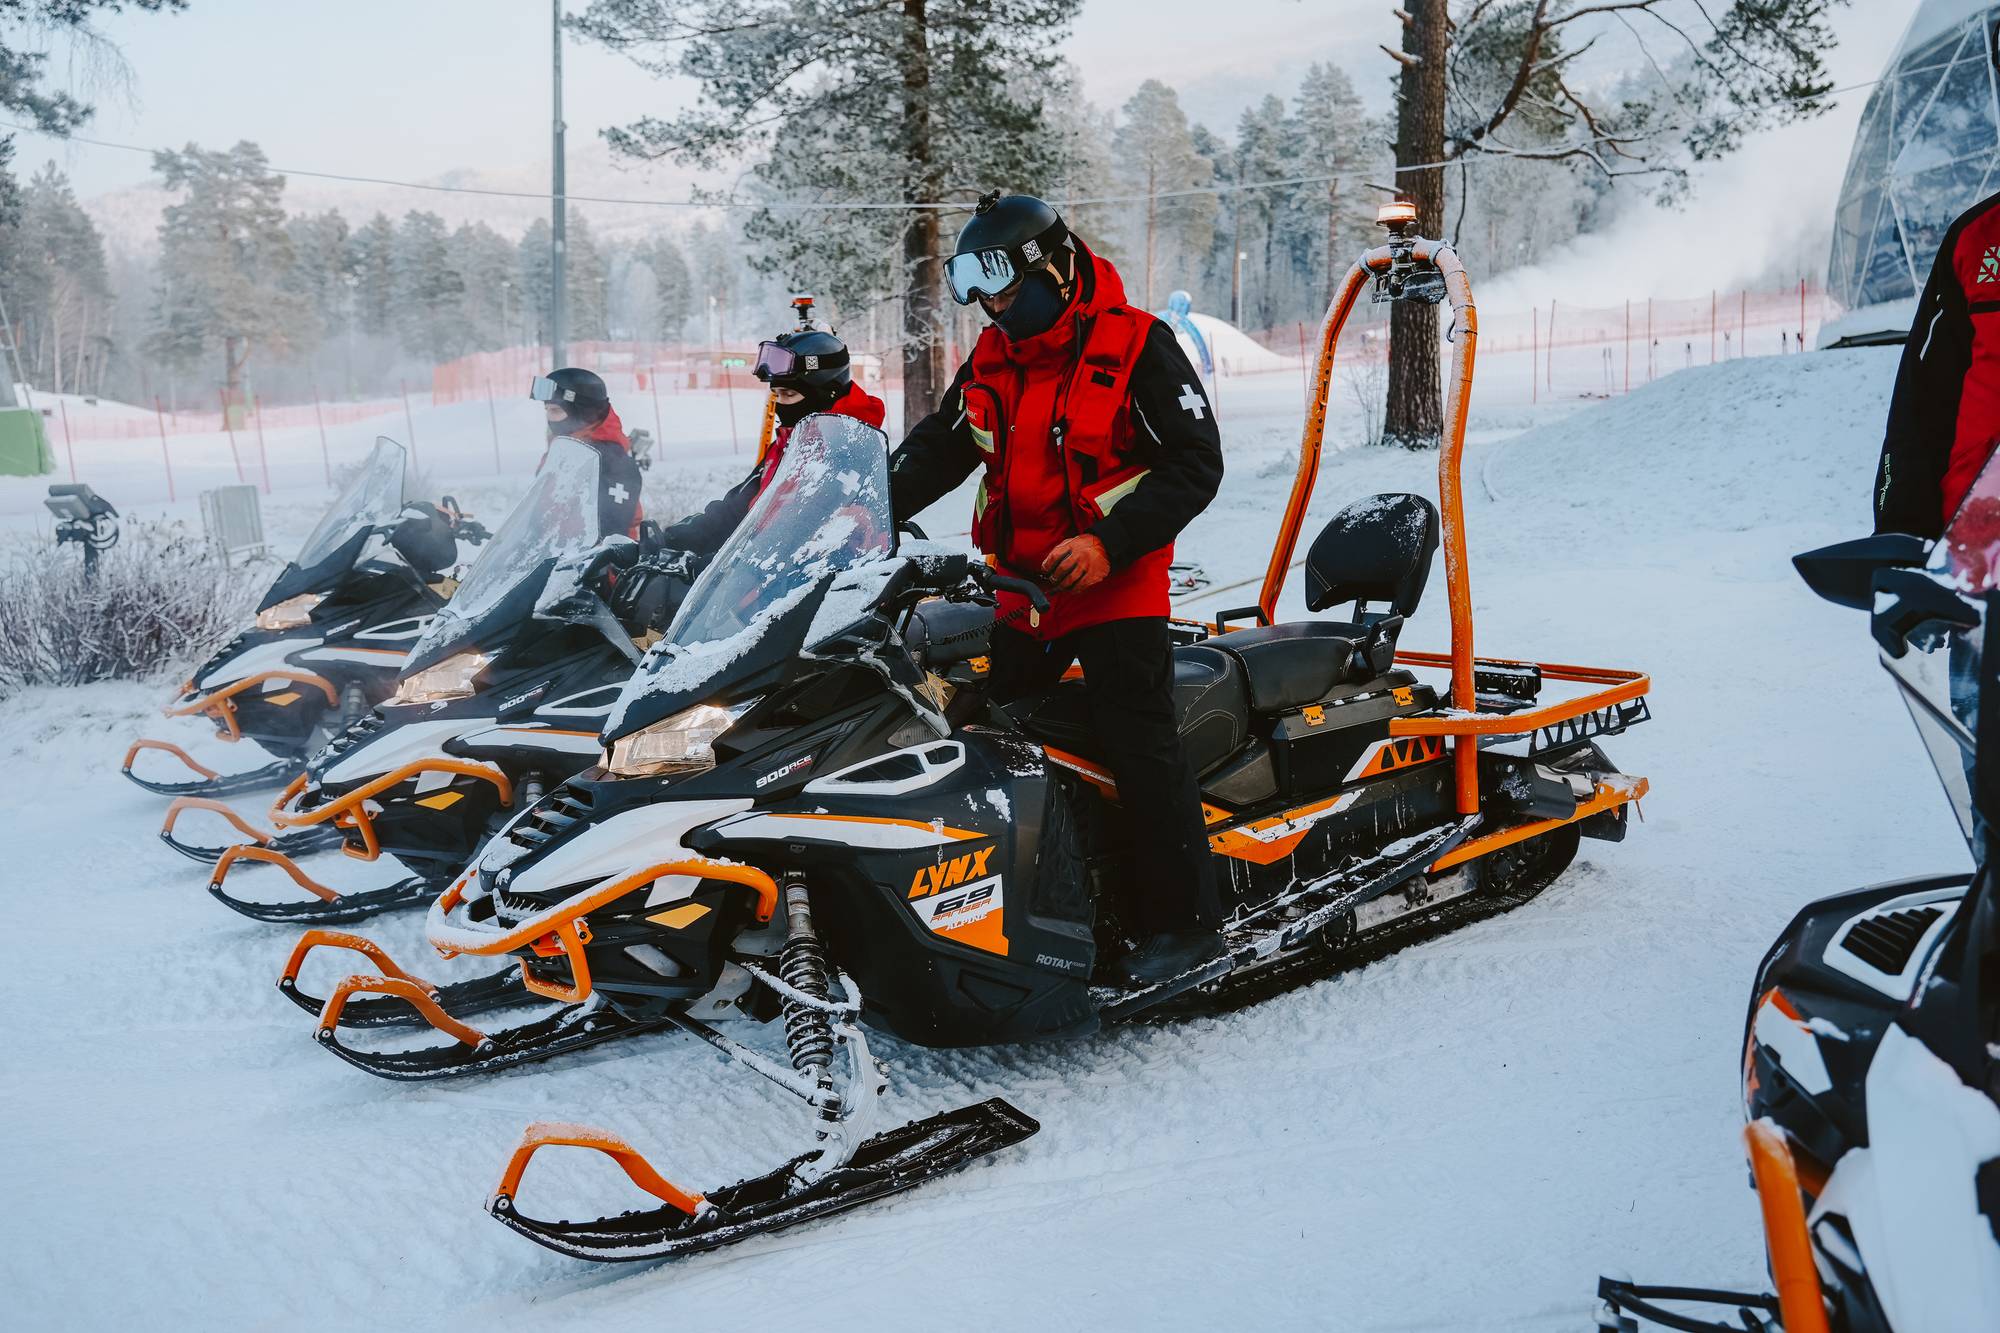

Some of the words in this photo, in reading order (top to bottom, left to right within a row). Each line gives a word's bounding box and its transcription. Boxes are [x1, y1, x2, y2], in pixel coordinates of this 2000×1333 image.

[907, 845, 996, 899] LYNX
[930, 897, 992, 923] RANGER
[933, 884, 996, 916] 69
[1035, 953, 1073, 970] ROTAX
